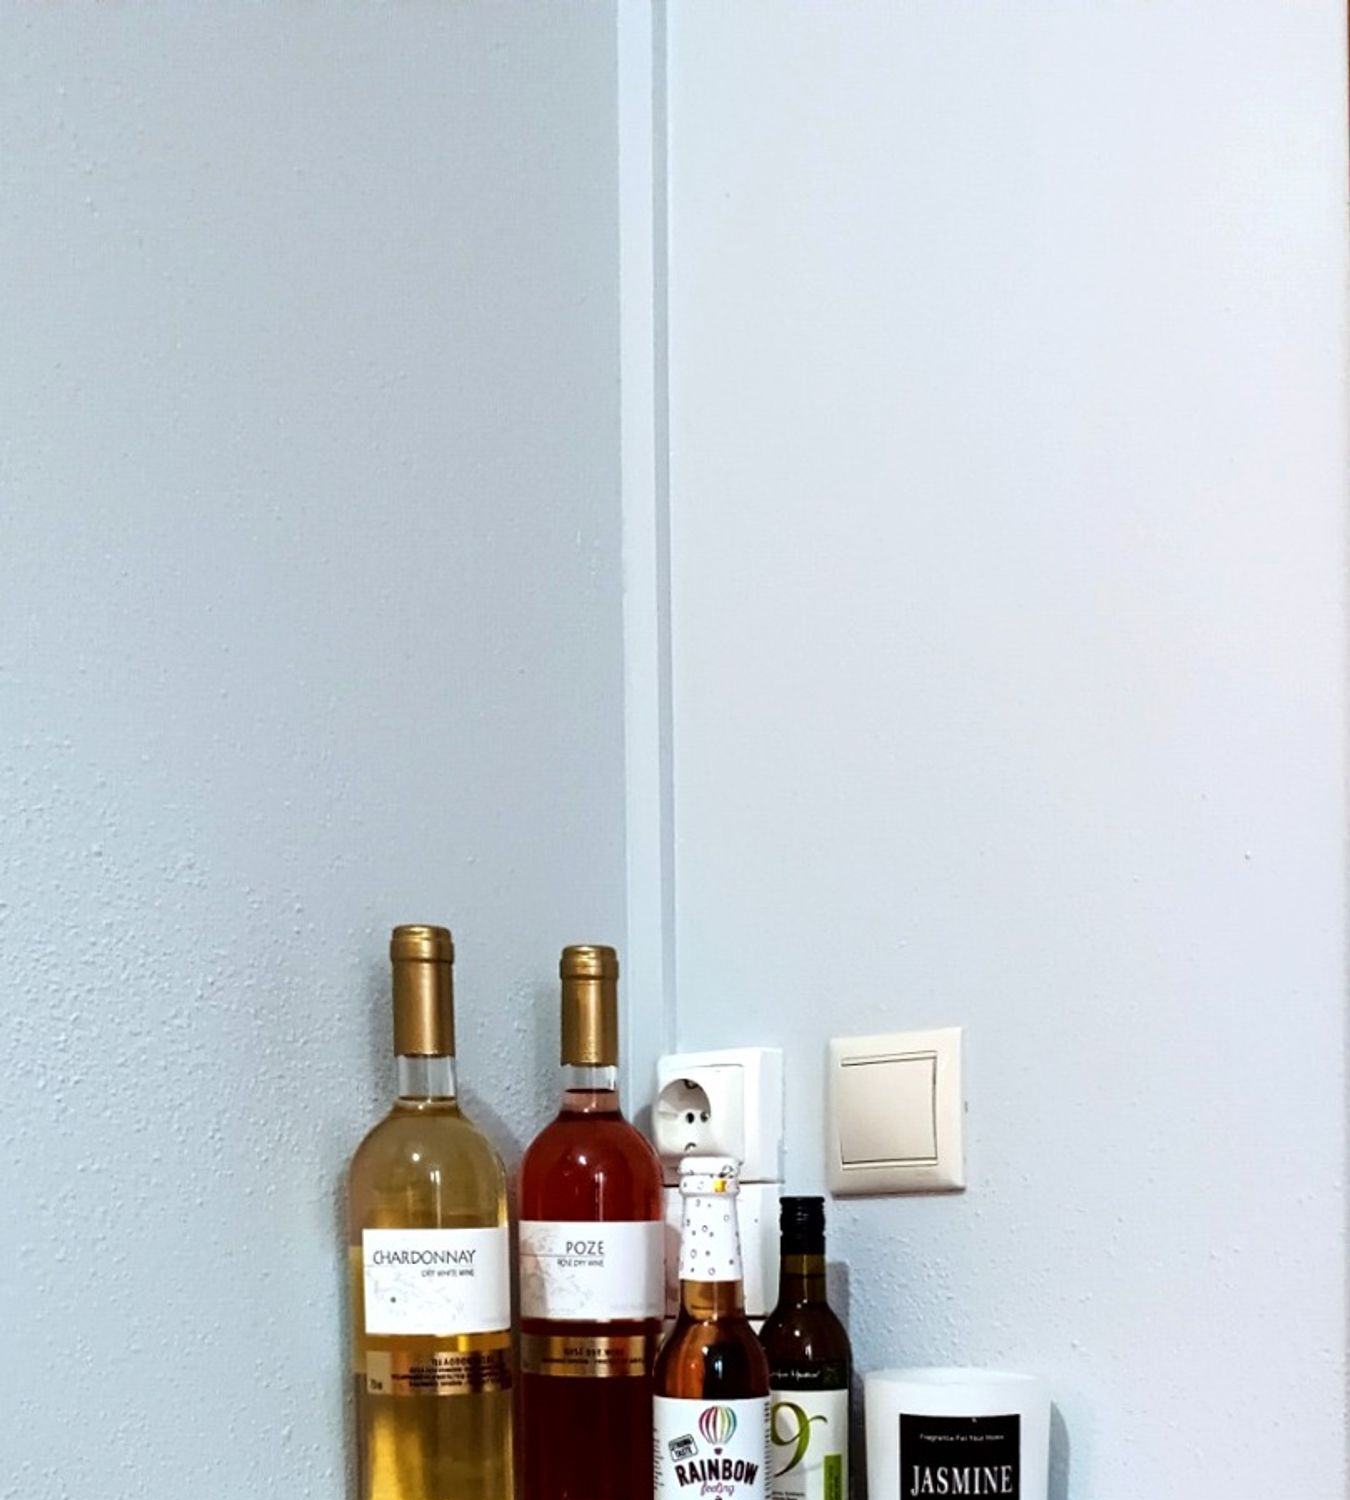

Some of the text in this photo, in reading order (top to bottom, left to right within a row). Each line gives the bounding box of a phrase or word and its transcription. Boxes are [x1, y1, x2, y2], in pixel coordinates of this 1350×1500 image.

[566, 1241, 605, 1256] POZE
[373, 1249, 476, 1265] CHARDONNAY
[674, 1458, 759, 1488] RAINBOW
[911, 1465, 1013, 1497] JASMINE
[700, 1481, 735, 1497] feeling
